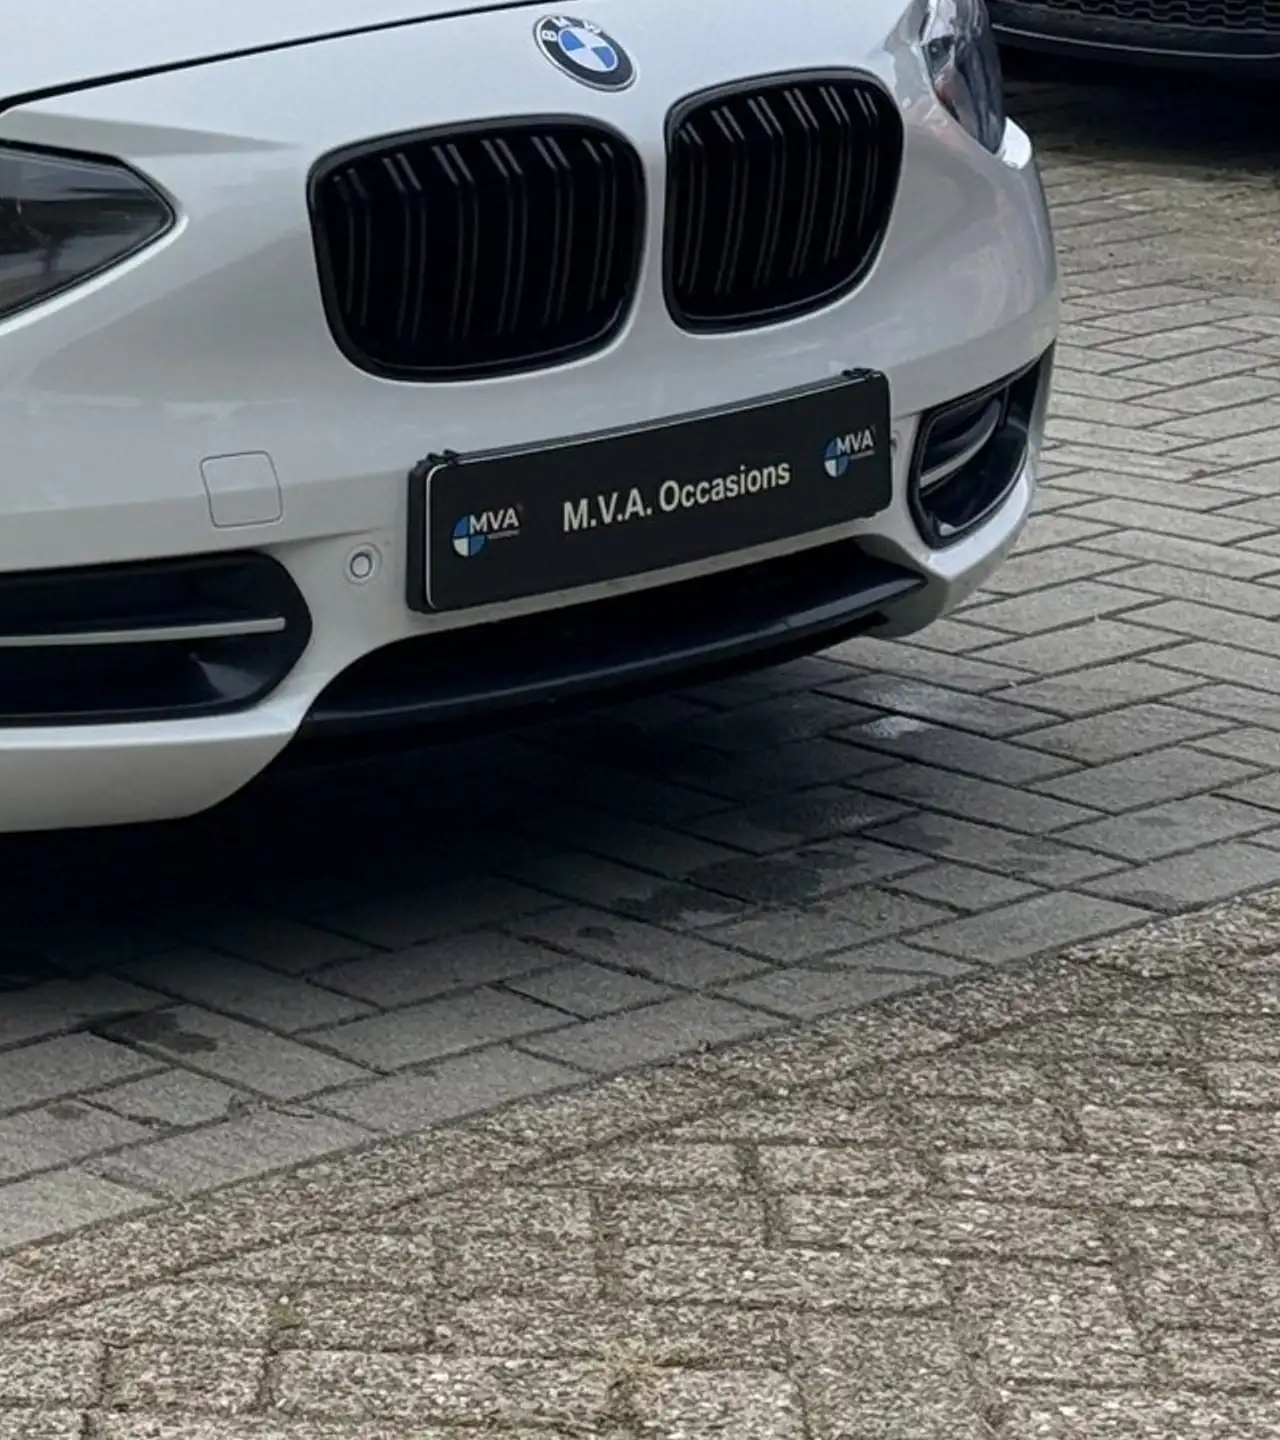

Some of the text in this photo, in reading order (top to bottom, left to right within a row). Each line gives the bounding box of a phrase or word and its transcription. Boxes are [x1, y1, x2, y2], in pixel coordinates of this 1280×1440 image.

[836, 429, 874, 456] MVA
[562, 460, 792, 532] M.V.A. Occasions
[469, 506, 520, 535] MVA
